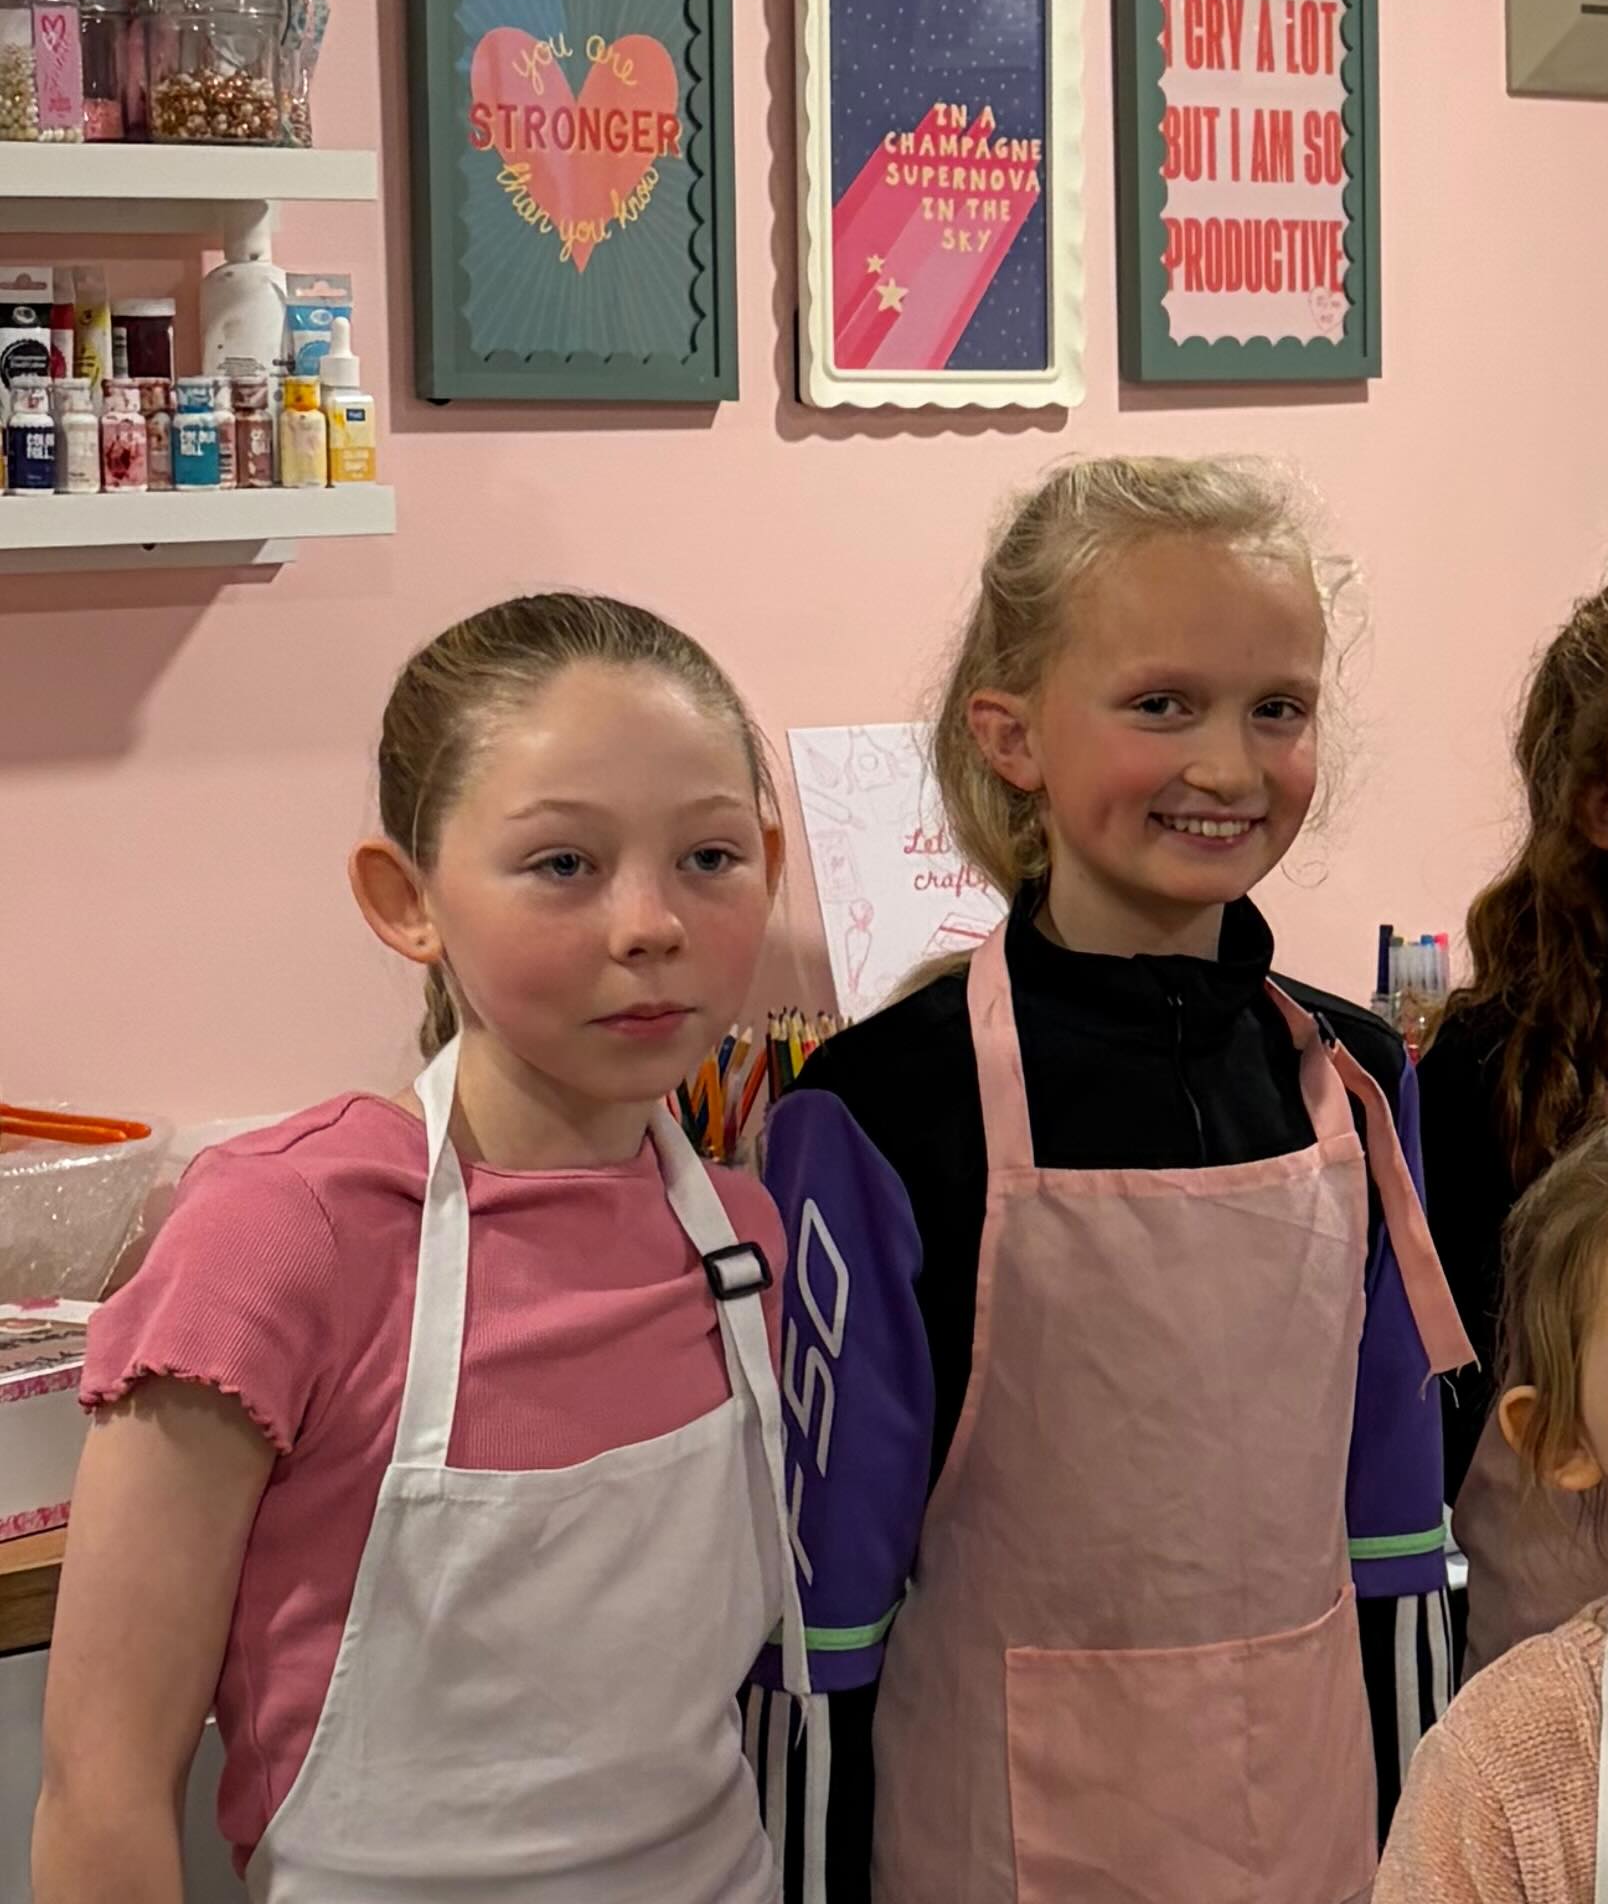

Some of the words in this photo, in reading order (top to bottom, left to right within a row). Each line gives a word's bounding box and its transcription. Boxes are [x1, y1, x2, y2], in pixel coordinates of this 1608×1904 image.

[512, 31, 574, 94] you
[586, 34, 638, 85] are
[1286, 0, 1337, 76] LOT
[469, 102, 683, 158] STRONGER
[933, 103, 969, 128] IN
[980, 104, 997, 128] A
[883, 131, 1042, 161] CHAMPAGNE
[1165, 105, 1220, 182] BUT
[1231, 108, 1241, 182] I
[1250, 108, 1294, 183] AM
[1304, 110, 1342, 186] SO
[884, 163, 1041, 192] SUPERNOVA
[495, 162, 553, 235] than
[559, 217, 612, 262] you
[611, 165, 658, 231] know
[920, 197, 955, 221] IN
[966, 199, 1011, 222] THE
[940, 228, 992, 253] SKY
[1164, 216, 1343, 294] PRODUCTIVE
